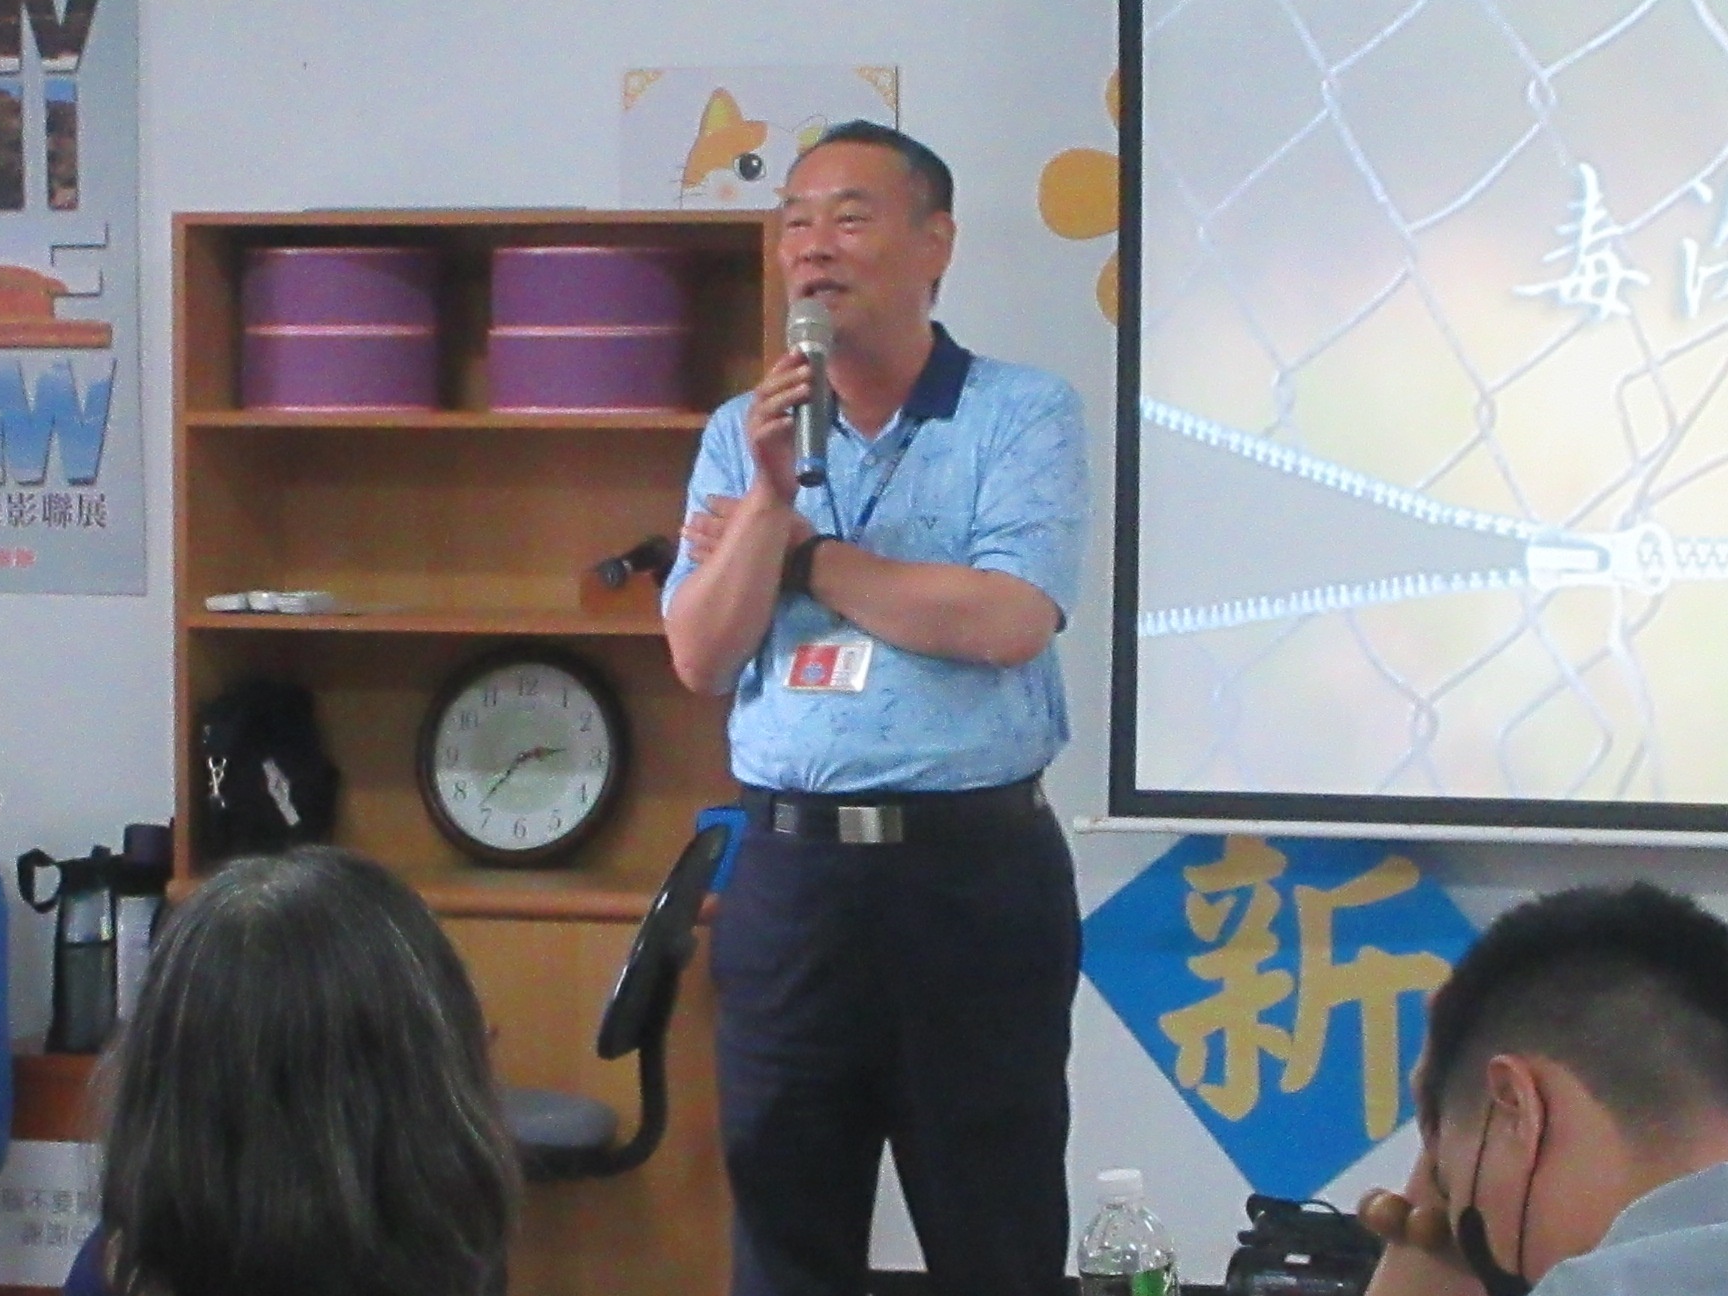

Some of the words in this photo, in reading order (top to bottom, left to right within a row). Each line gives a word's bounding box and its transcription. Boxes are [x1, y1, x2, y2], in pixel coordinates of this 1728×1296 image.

[482, 684, 499, 708] 11
[517, 675, 540, 697] 12
[578, 710, 593, 733] 2
[453, 778, 468, 801] 8
[479, 807, 493, 830] 7
[513, 817, 528, 840] 6
[547, 808, 562, 832] 5
[1157, 834, 1454, 1142] 新
